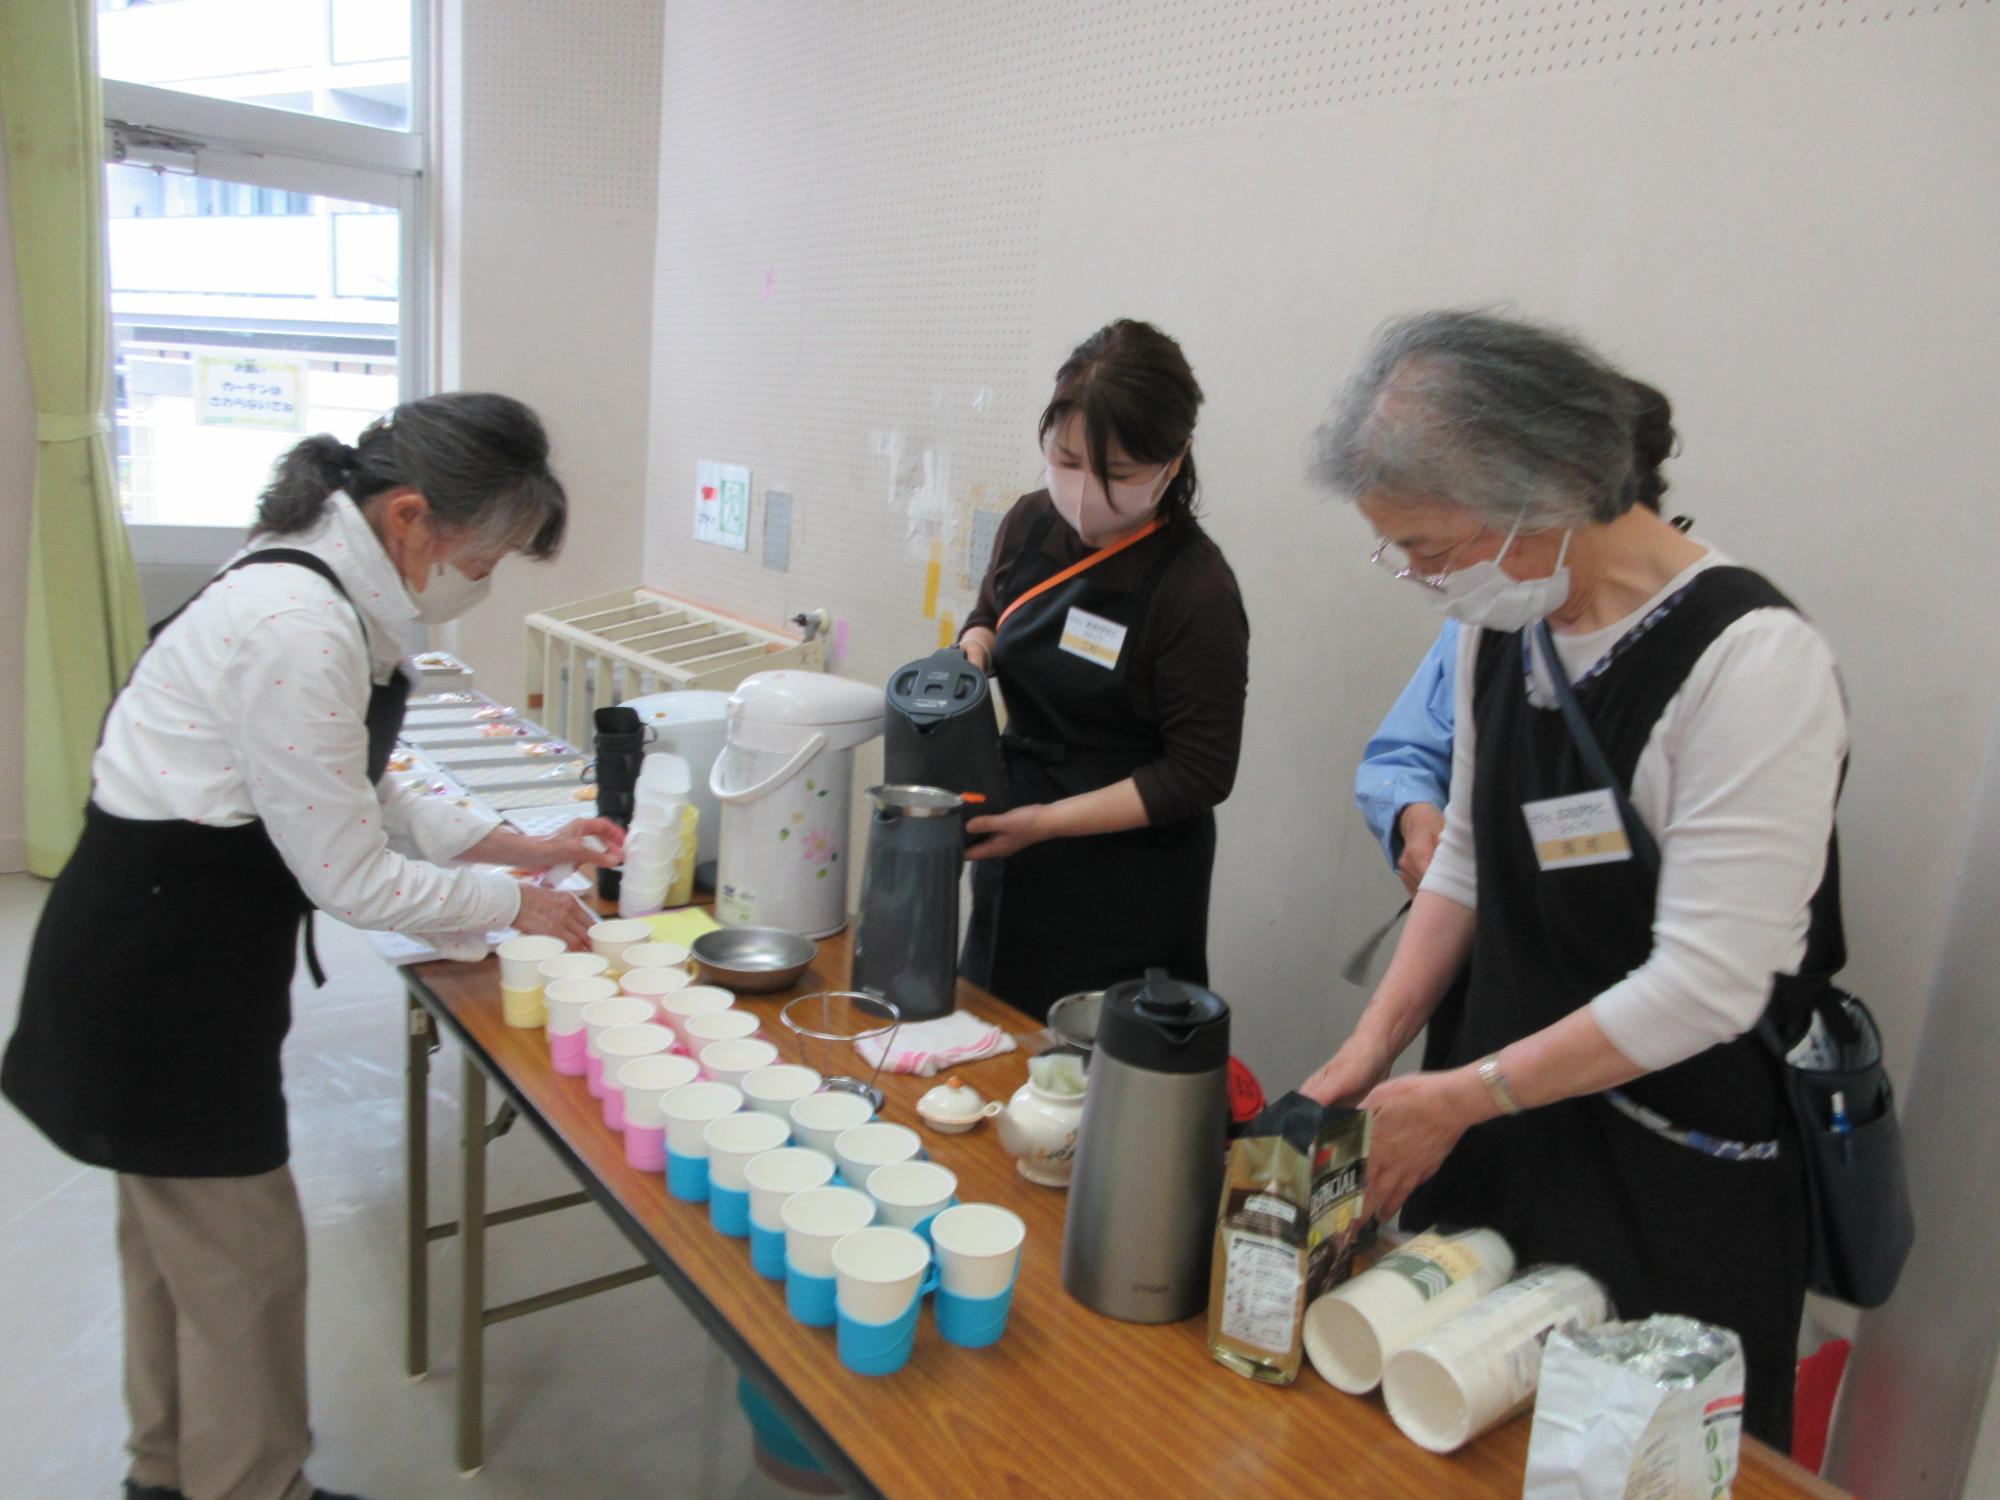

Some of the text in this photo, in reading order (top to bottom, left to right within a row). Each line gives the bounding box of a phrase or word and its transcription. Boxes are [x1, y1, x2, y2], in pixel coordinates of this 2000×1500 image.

[221, 381, 283, 397] カーテンは
